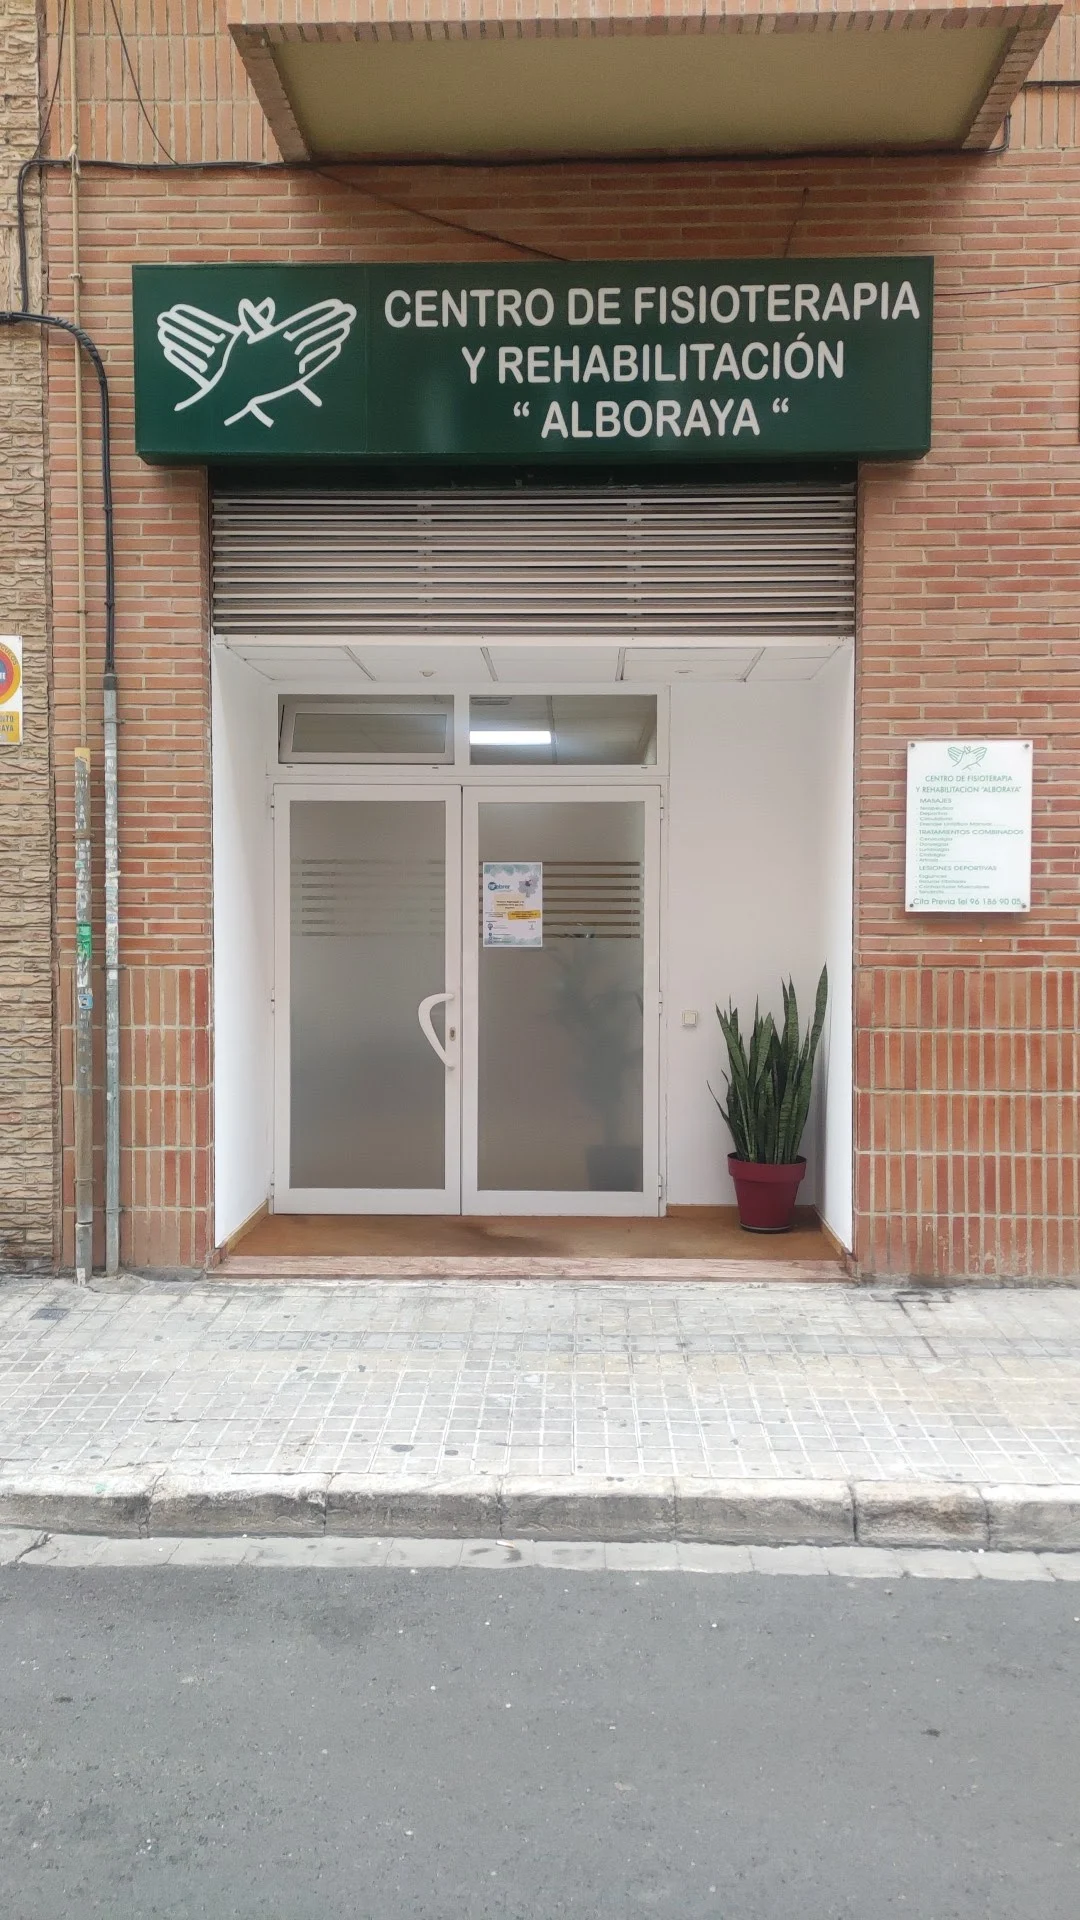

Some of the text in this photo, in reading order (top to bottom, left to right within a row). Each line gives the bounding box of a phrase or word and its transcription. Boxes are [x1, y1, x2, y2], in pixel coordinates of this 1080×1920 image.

[384, 280, 920, 328] CENTRO DE FISIOTERAPIA
[461, 332, 844, 384] Y REHABILITACIÓN
[540, 398, 760, 438] ALBORAYA
[912, 897, 930, 905] Cita
[931, 897, 956, 905] Previa
[969, 897, 980, 905] 96
[999, 897, 1010, 905] 90
